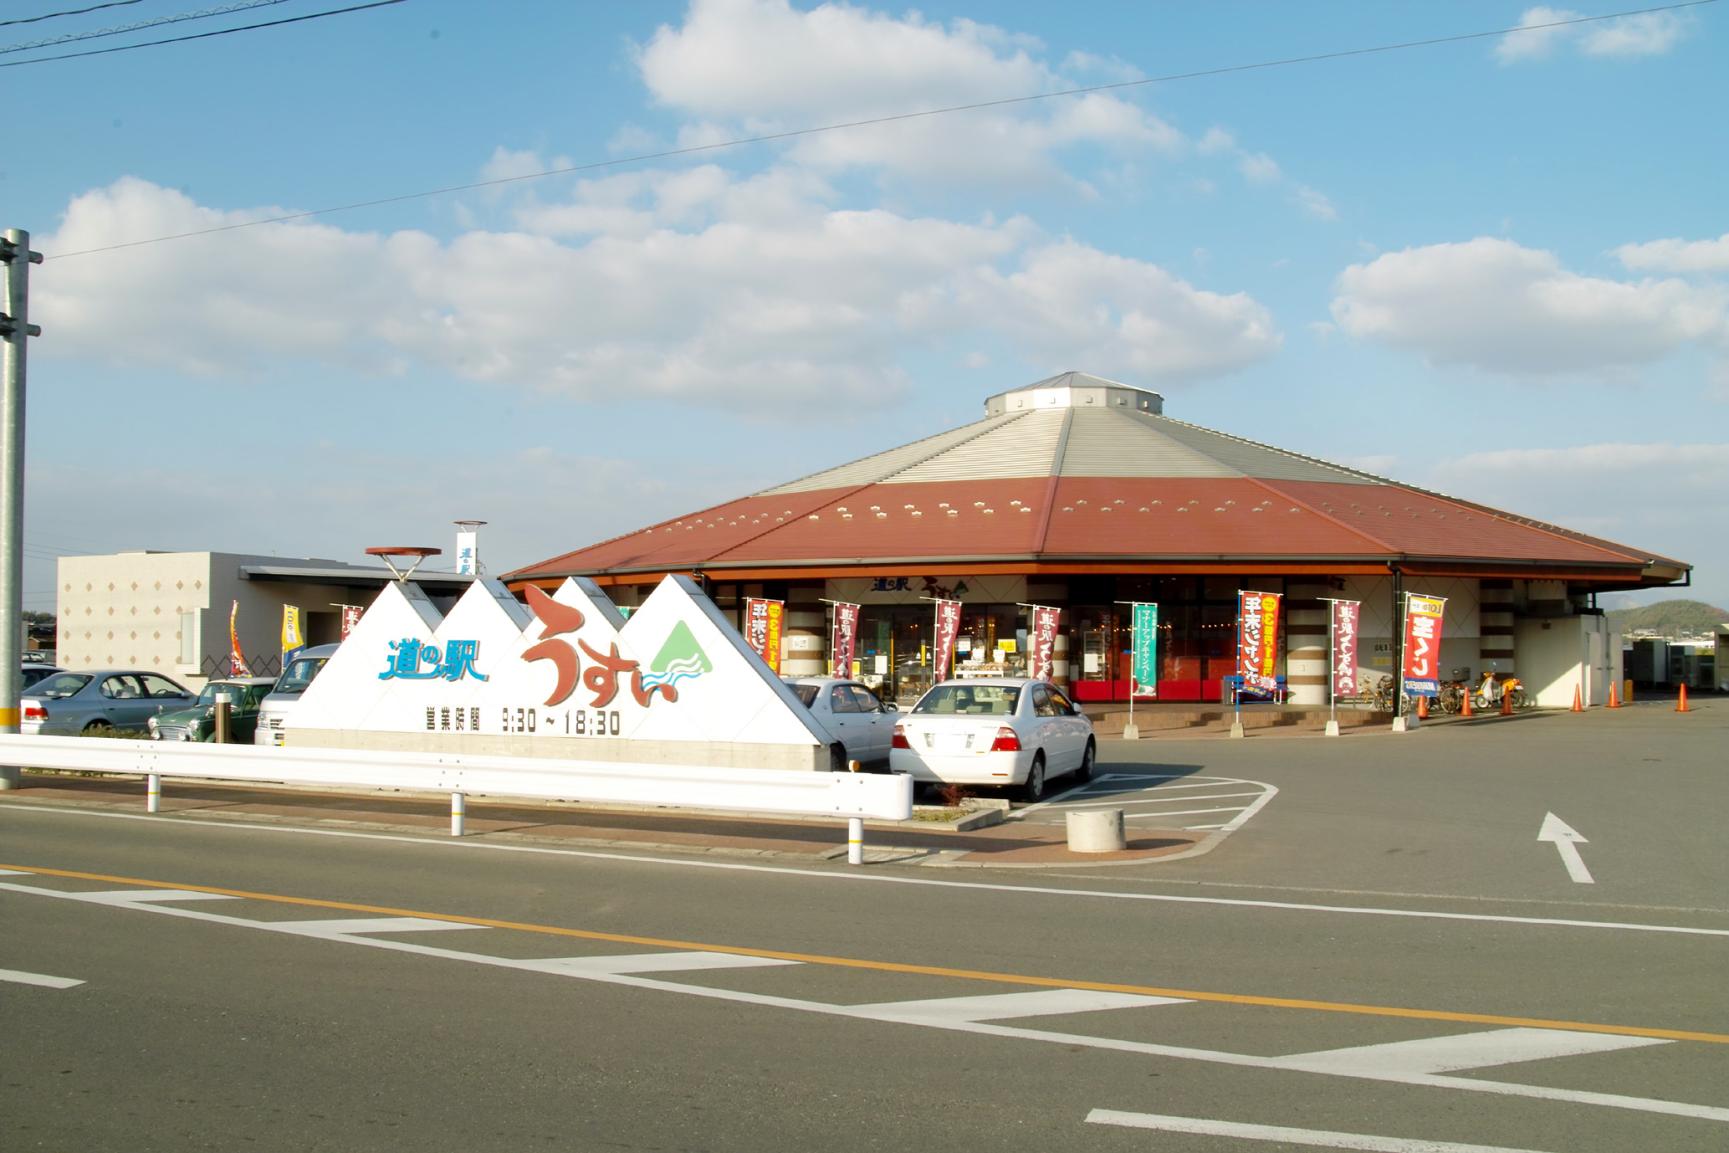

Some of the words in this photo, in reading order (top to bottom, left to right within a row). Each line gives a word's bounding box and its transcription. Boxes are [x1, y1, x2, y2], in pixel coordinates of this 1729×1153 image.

[378, 638, 490, 682] 道の駅
[520, 583, 679, 709] うすい
[426, 706, 480, 731] 営業時間
